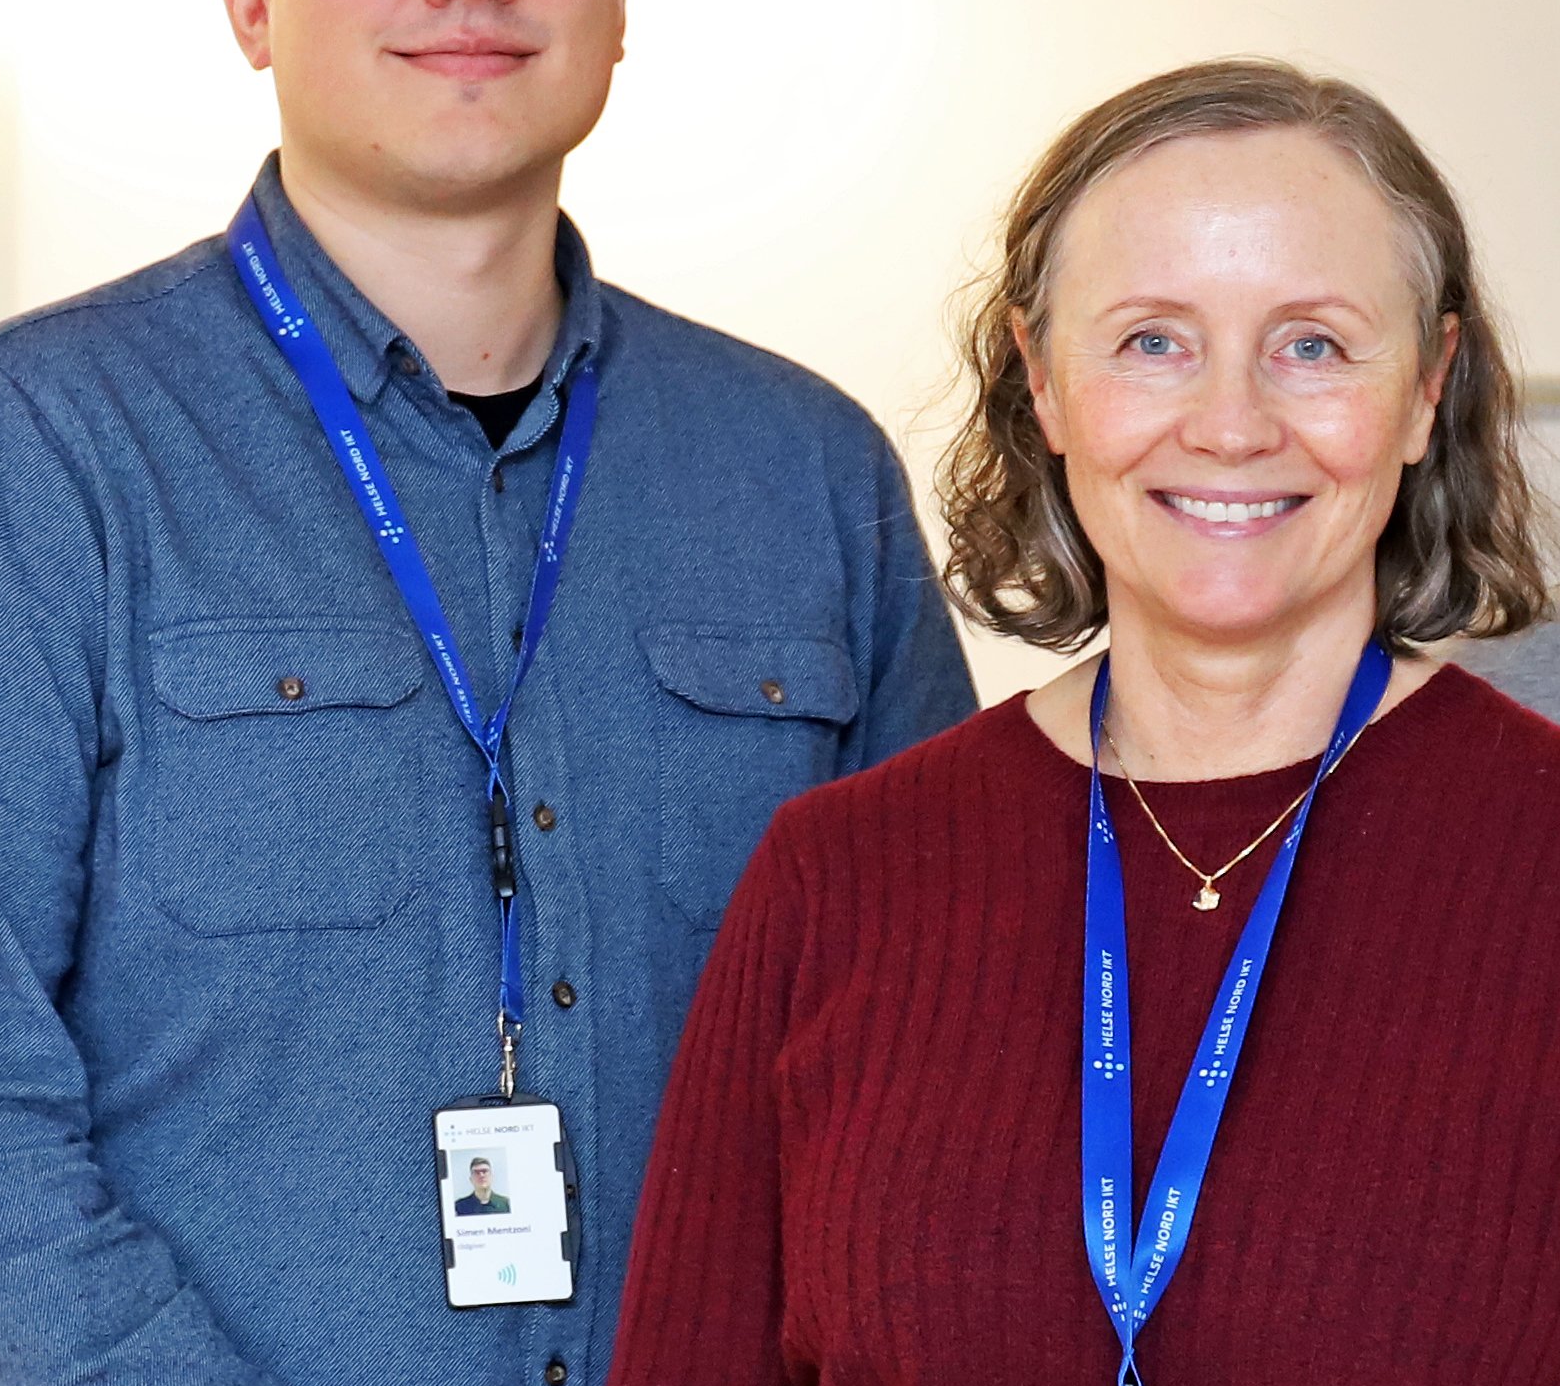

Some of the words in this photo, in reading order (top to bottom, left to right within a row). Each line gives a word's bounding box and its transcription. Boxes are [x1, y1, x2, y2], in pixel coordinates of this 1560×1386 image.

[242, 241, 255, 257] IKT
[250, 255, 269, 285] NORD
[262, 282, 286, 315] HELSE
[340, 429, 356, 447] IKT
[350, 447, 371, 482] NORD
[365, 482, 388, 517] HELSE
[432, 633, 446, 650] IKT
[442, 652, 461, 686] NORD
[1101, 949, 1113, 970] IKT
[1101, 971, 1113, 1008] NORD
[1214, 1016, 1234, 1055] HELSE
[1225, 978, 1247, 1014] NORD
[1239, 958, 1253, 977] IKT
[1101, 1010, 1114, 1047] HELSE
[494, 1125, 520, 1134] NORD
[1101, 1177, 1114, 1197] IKT
[1102, 1199, 1115, 1241] NORD
[1141, 1253, 1164, 1294] HELSE
[1155, 1210, 1175, 1252] NORD
[1166, 1187, 1181, 1209] IKT
[1104, 1243, 1117, 1287] HELSE
